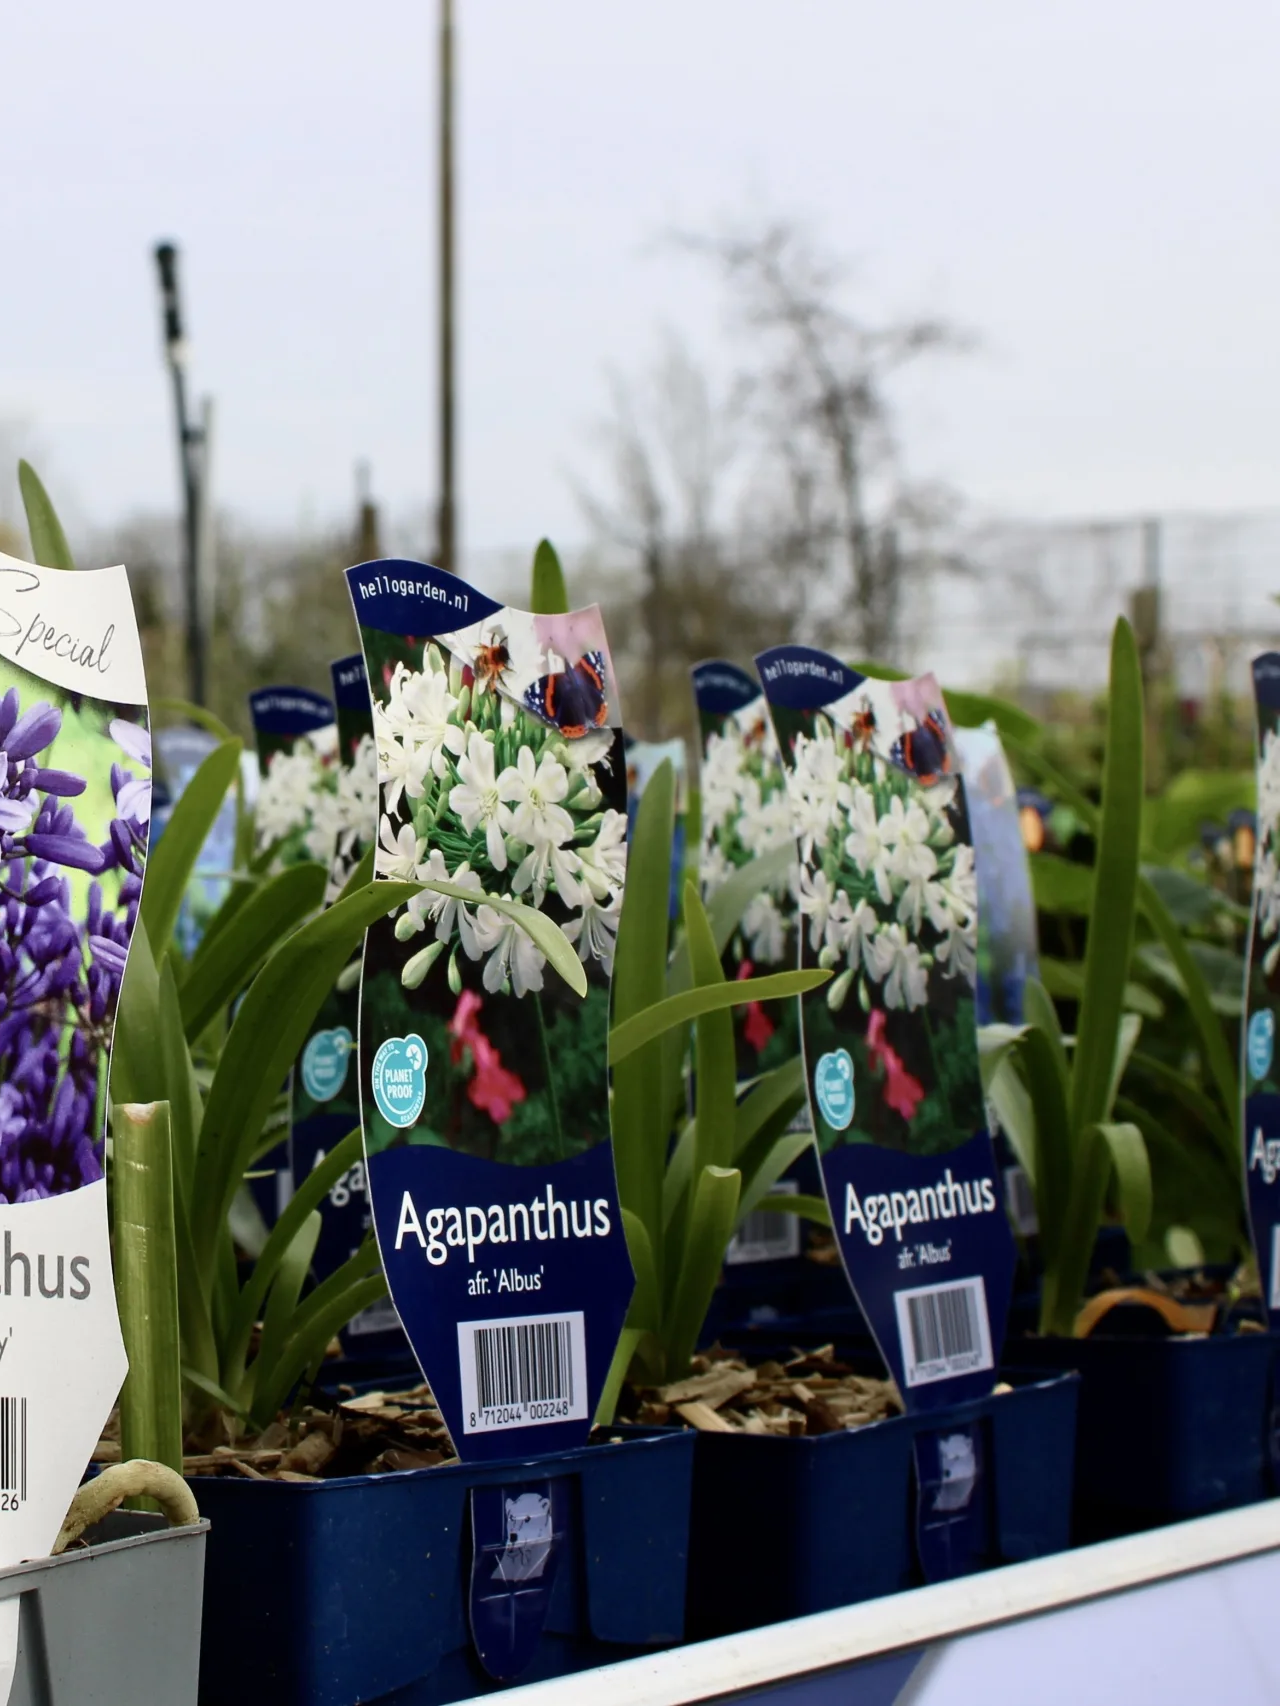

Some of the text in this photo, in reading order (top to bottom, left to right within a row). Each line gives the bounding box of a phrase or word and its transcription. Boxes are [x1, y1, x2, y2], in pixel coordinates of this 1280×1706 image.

[359, 576, 468, 612] hellogarden.nl
[764, 659, 843, 685] hellogarden.nl
[385, 1069, 413, 1084] PLANET
[387, 1085, 413, 1099] PROOF
[845, 1168, 996, 1246] Agapanthus
[394, 1184, 611, 1266] Agapanthus
[468, 1265, 544, 1295] afr. 'Albus'
[470, 1401, 569, 1427] 8 712044 002248
